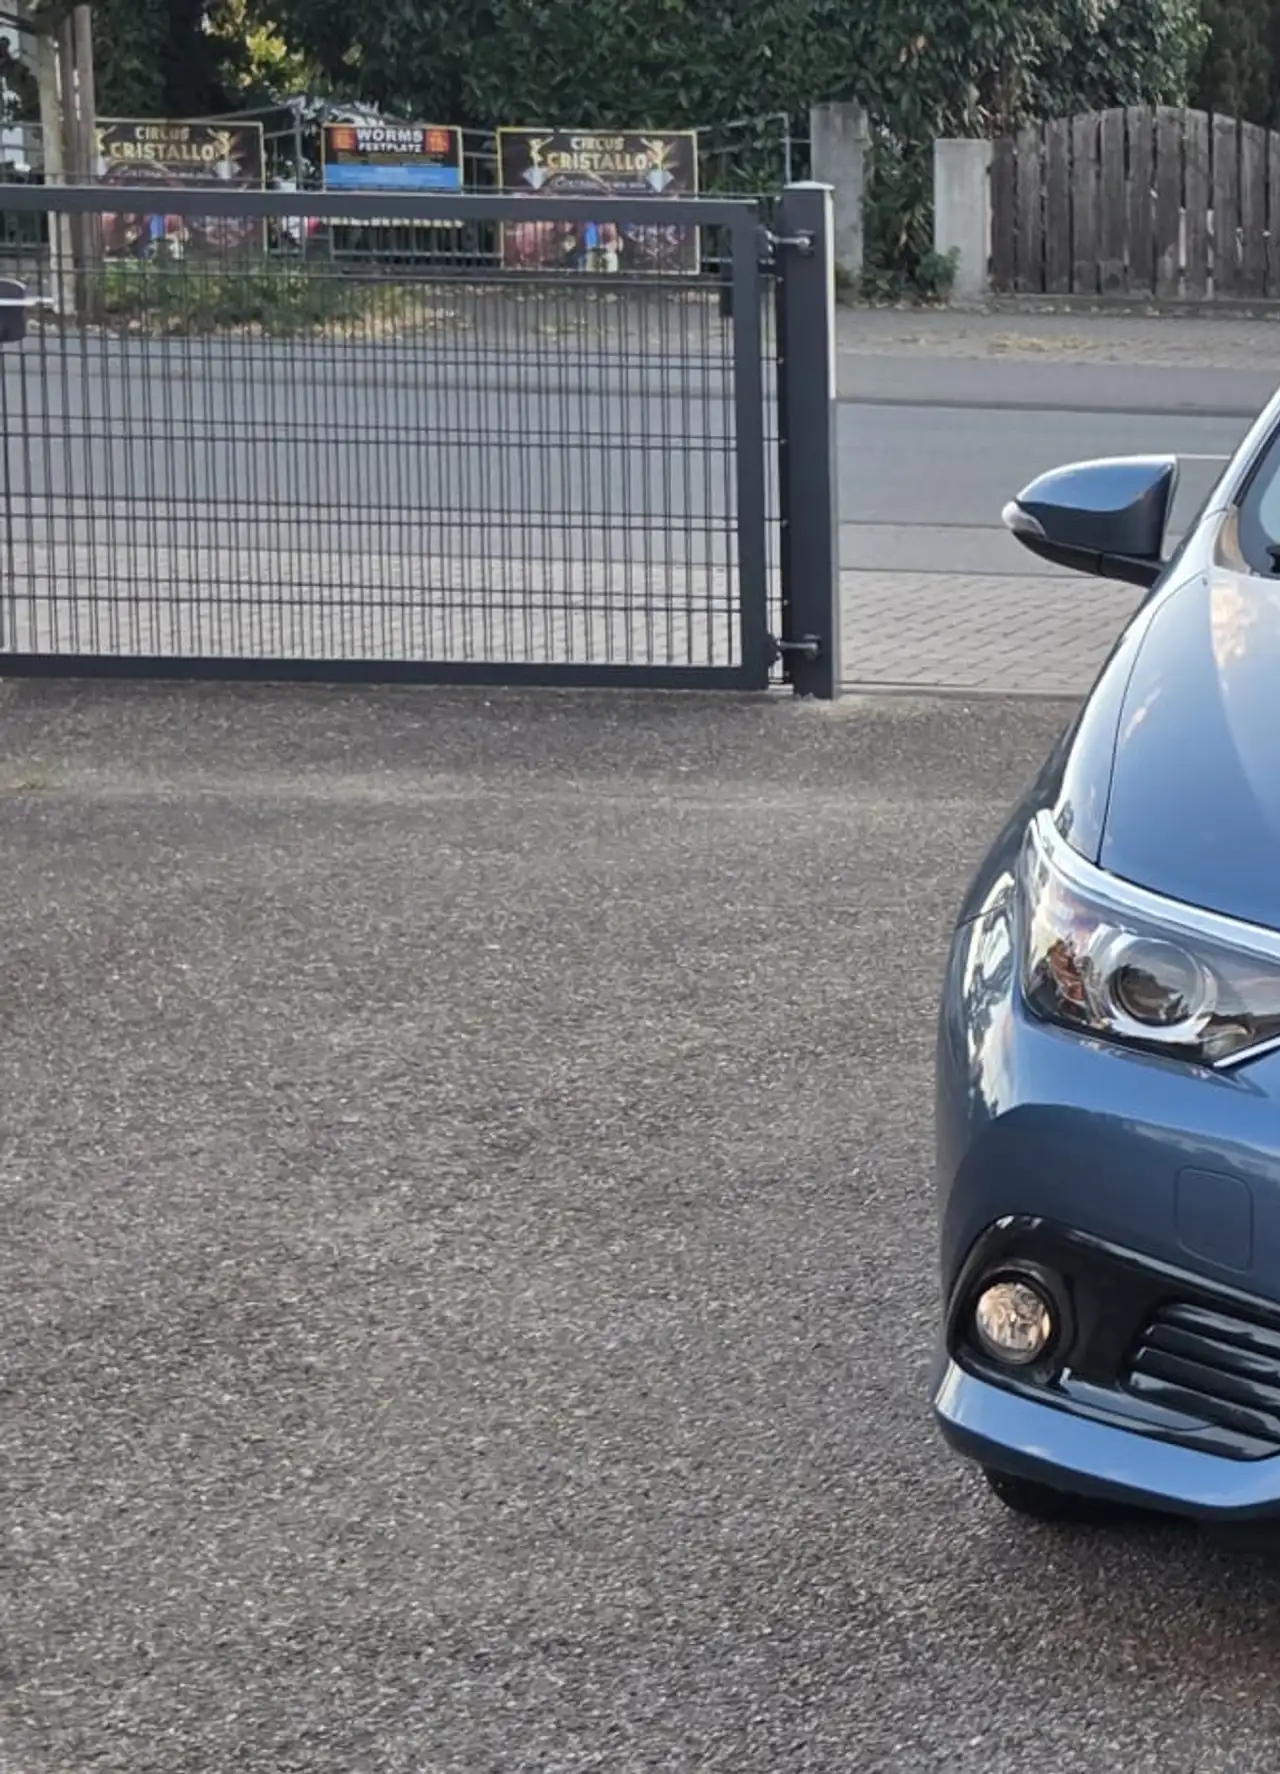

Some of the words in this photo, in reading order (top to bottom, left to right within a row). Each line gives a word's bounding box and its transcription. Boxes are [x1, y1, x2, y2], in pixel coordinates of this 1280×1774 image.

[134, 126, 190, 140] CIRCUS
[356, 128, 424, 142] WORMS
[570, 136, 624, 150] CIRCUS
[110, 141, 214, 161] CRISTALLO
[547, 151, 647, 171] CRISTALLO
